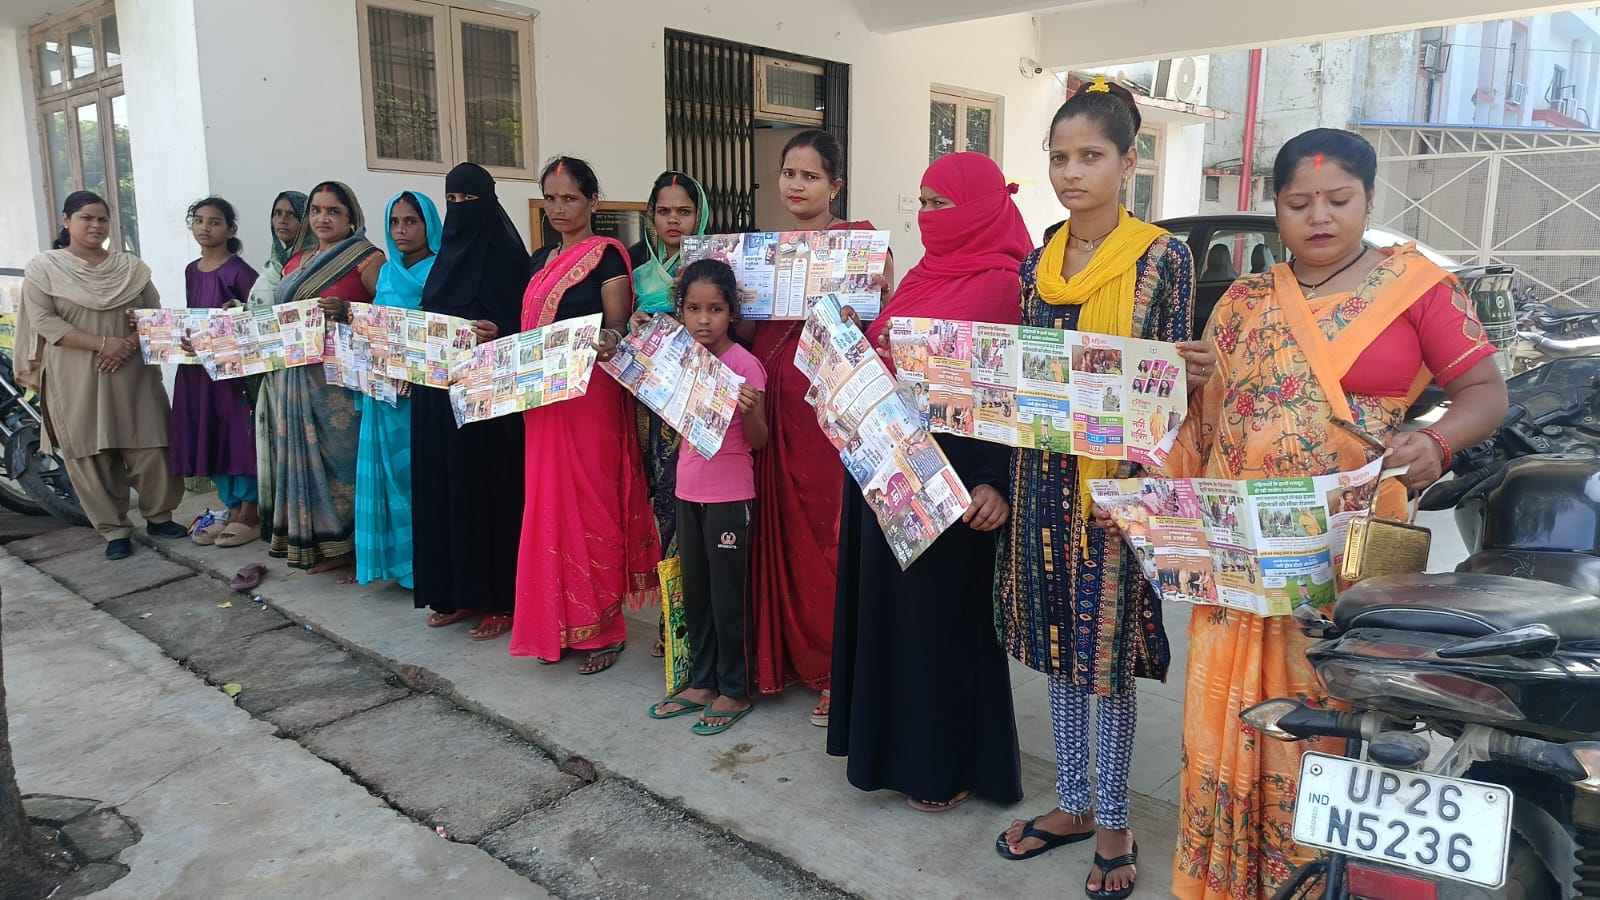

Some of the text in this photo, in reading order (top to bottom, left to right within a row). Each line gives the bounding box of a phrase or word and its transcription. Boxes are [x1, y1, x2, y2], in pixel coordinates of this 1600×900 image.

[1308, 792, 1330, 806] IND
[1347, 766, 1463, 822] UP26
[1326, 805, 1473, 873] N5236
